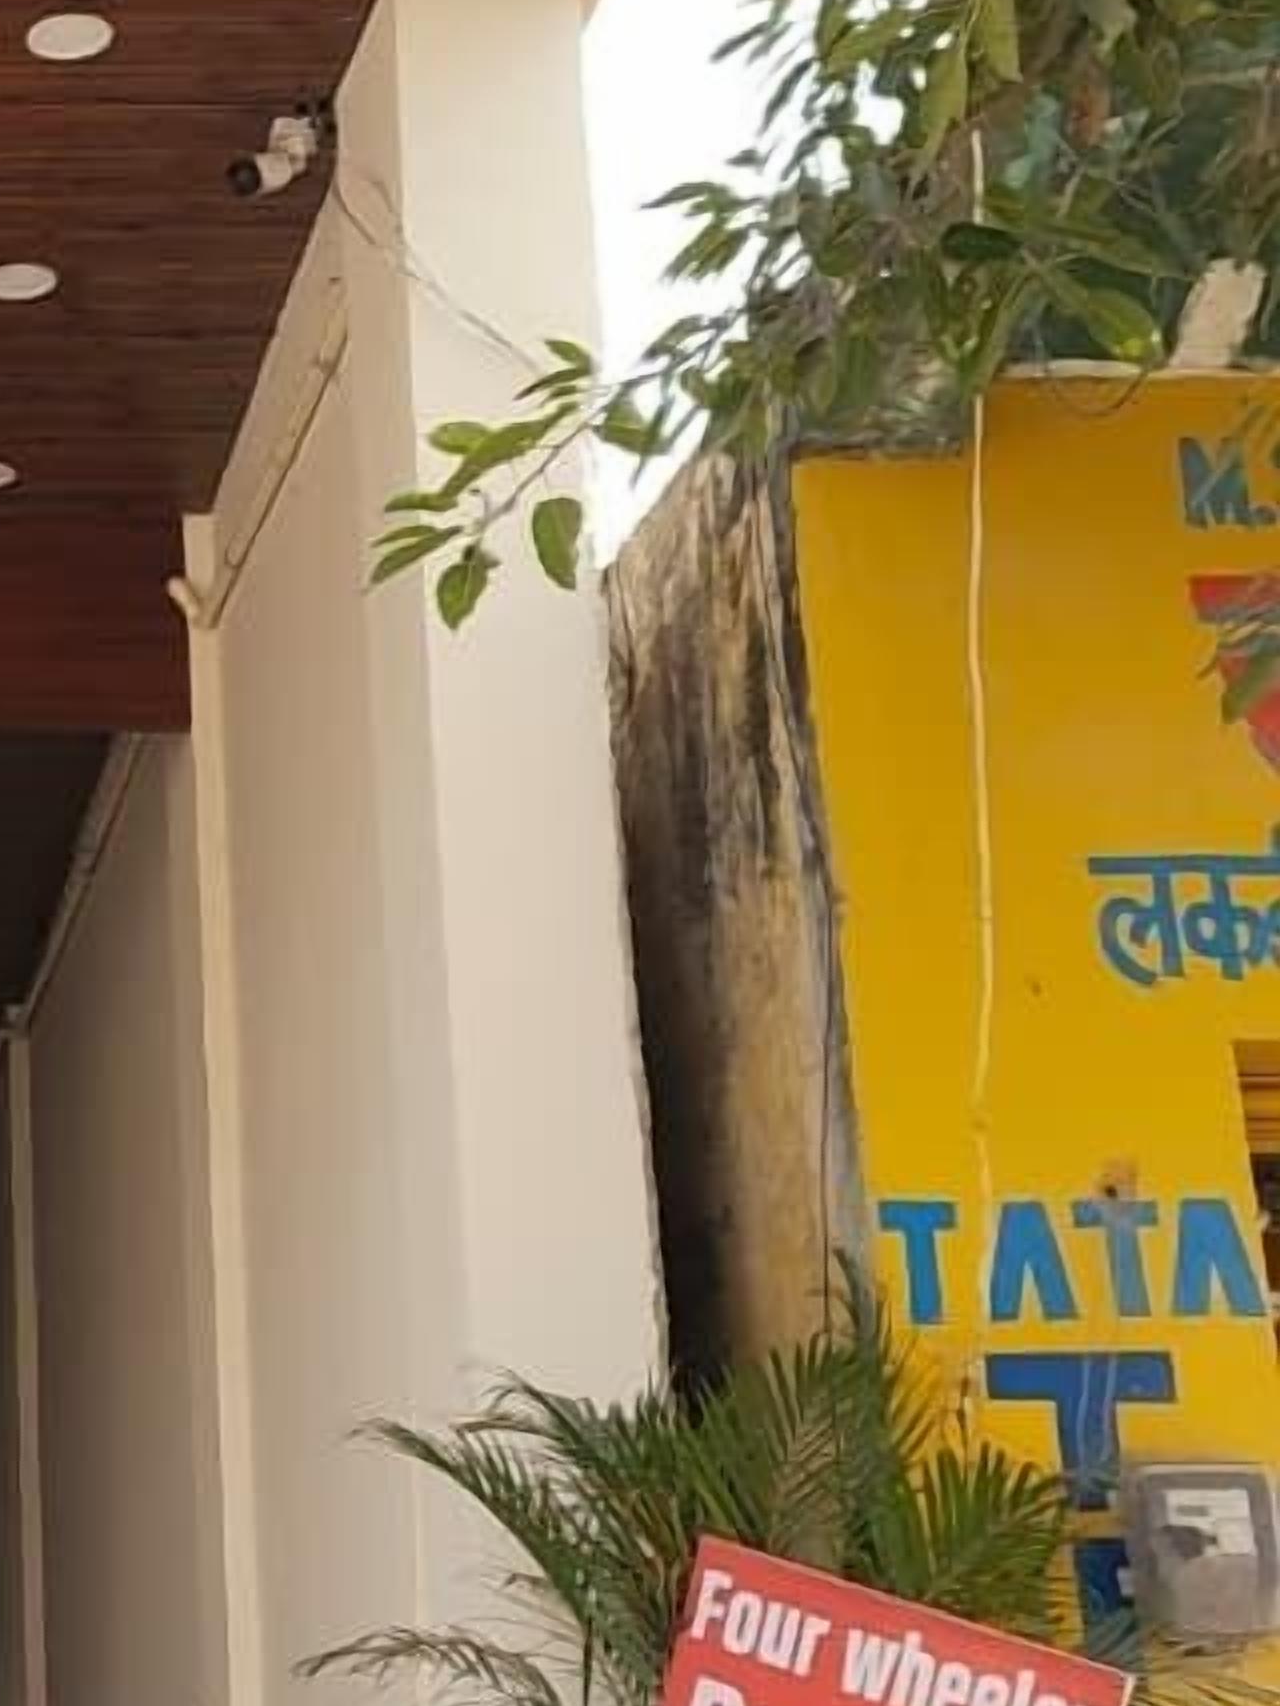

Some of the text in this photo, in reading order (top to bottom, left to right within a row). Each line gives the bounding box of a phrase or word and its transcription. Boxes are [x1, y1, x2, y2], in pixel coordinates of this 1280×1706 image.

[1088, 824, 1280, 986] लक
[879, 1200, 1266, 1324] TATA
[690, 1569, 830, 1677] Four
